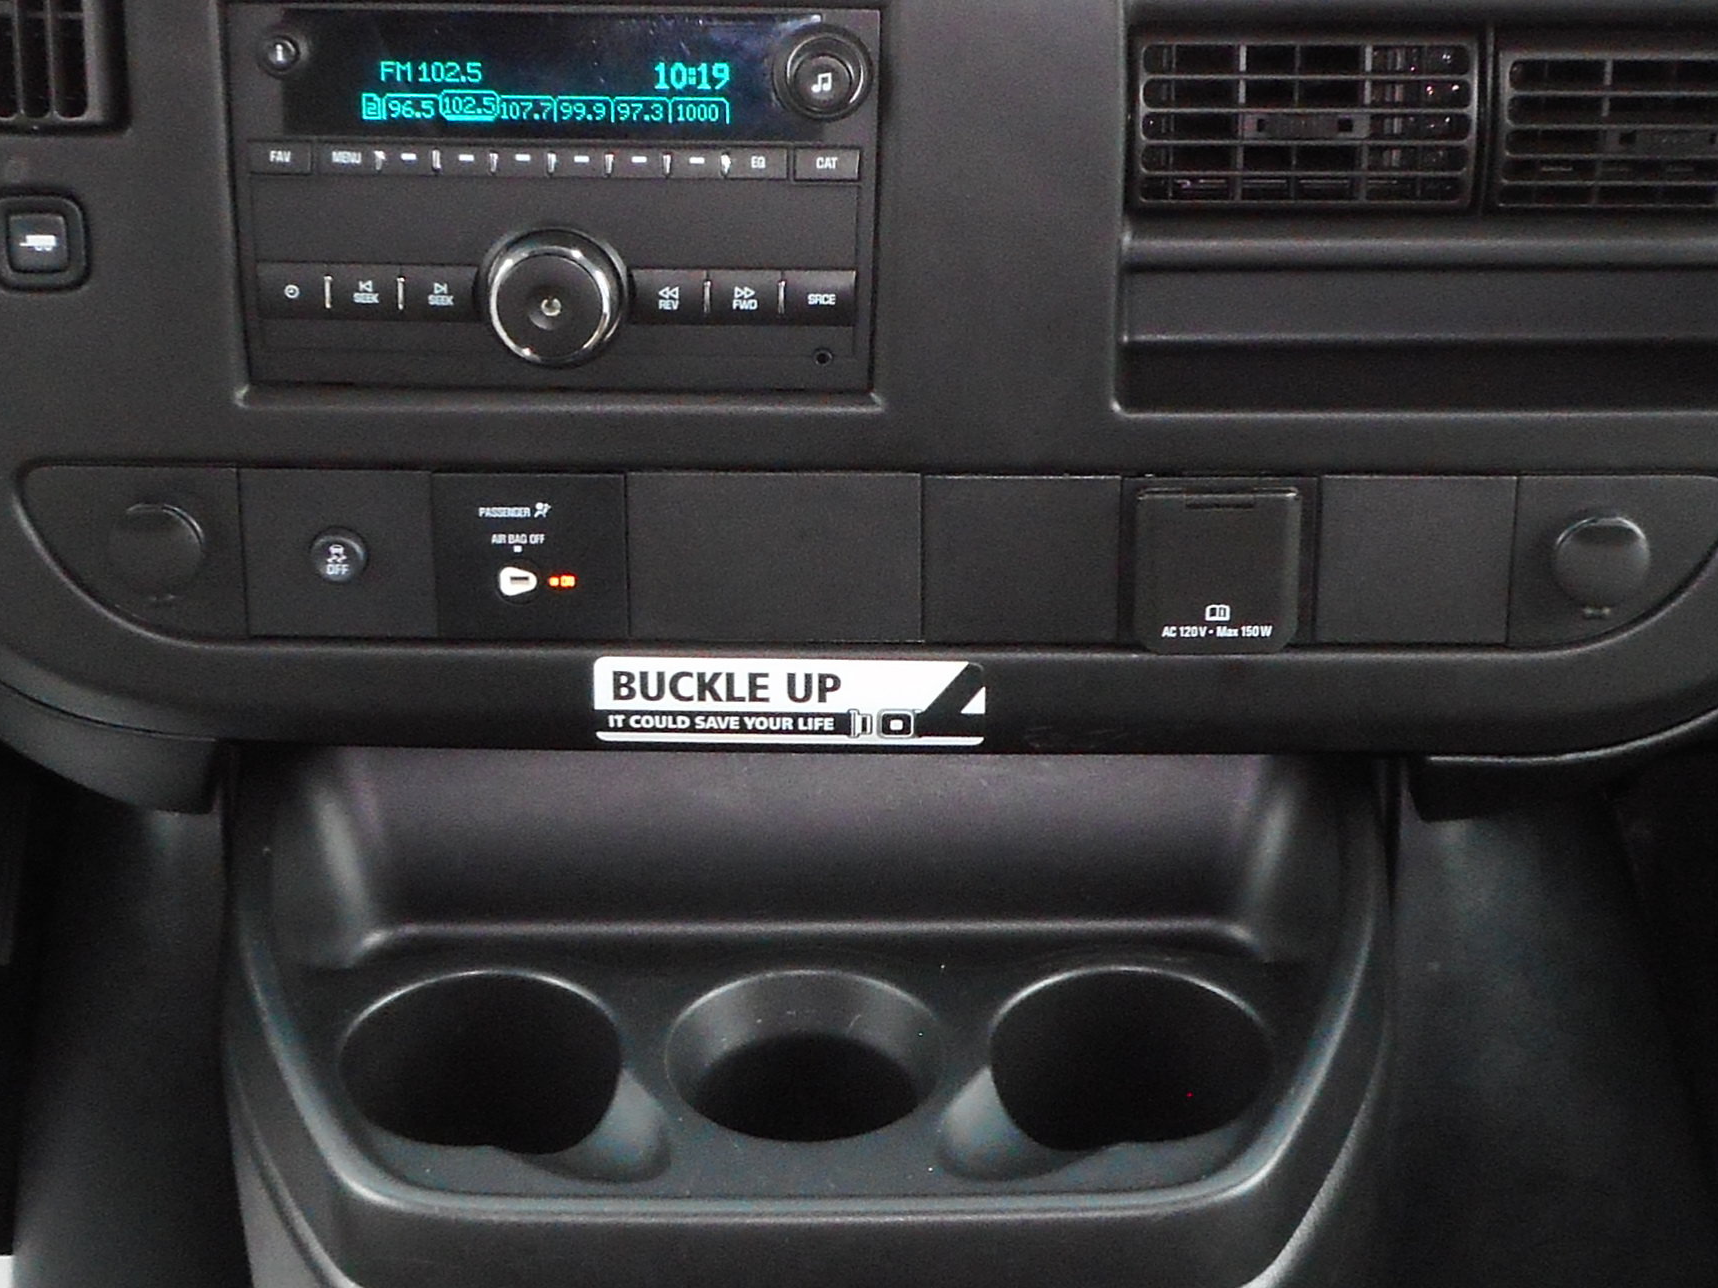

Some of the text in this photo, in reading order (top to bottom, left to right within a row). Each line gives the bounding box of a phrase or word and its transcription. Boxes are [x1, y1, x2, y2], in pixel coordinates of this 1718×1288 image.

[380, 61, 483, 84] FM 102.5
[654, 62, 731, 90] 10:19
[387, 100, 435, 119] 96.5
[443, 96, 496, 115] 102.5
[499, 103, 552, 121] 107.7
[559, 103, 605, 121] 99.9
[618, 103, 664, 121] 97.3
[676, 103, 719, 122] 1000
[269, 150, 291, 162] FAV
[332, 151, 362, 164] MENU
[750, 155, 766, 169] EQ
[816, 156, 838, 169] CAT
[353, 292, 379, 304] SEEK
[428, 294, 454, 306] SEEK
[807, 293, 836, 305] SRCE
[658, 299, 680, 311] REV
[732, 299, 758, 311] FWD
[478, 506, 531, 518] PASSENGER
[491, 533, 545, 545] AIR BAG OFF
[326, 564, 349, 576] OFF
[1161, 625, 1177, 637] AC
[1216, 625, 1239, 637] Max
[611, 670, 842, 704] BUCKLE UP
[608, 714, 836, 732] IT COULD SAVE YOUR LIFE
